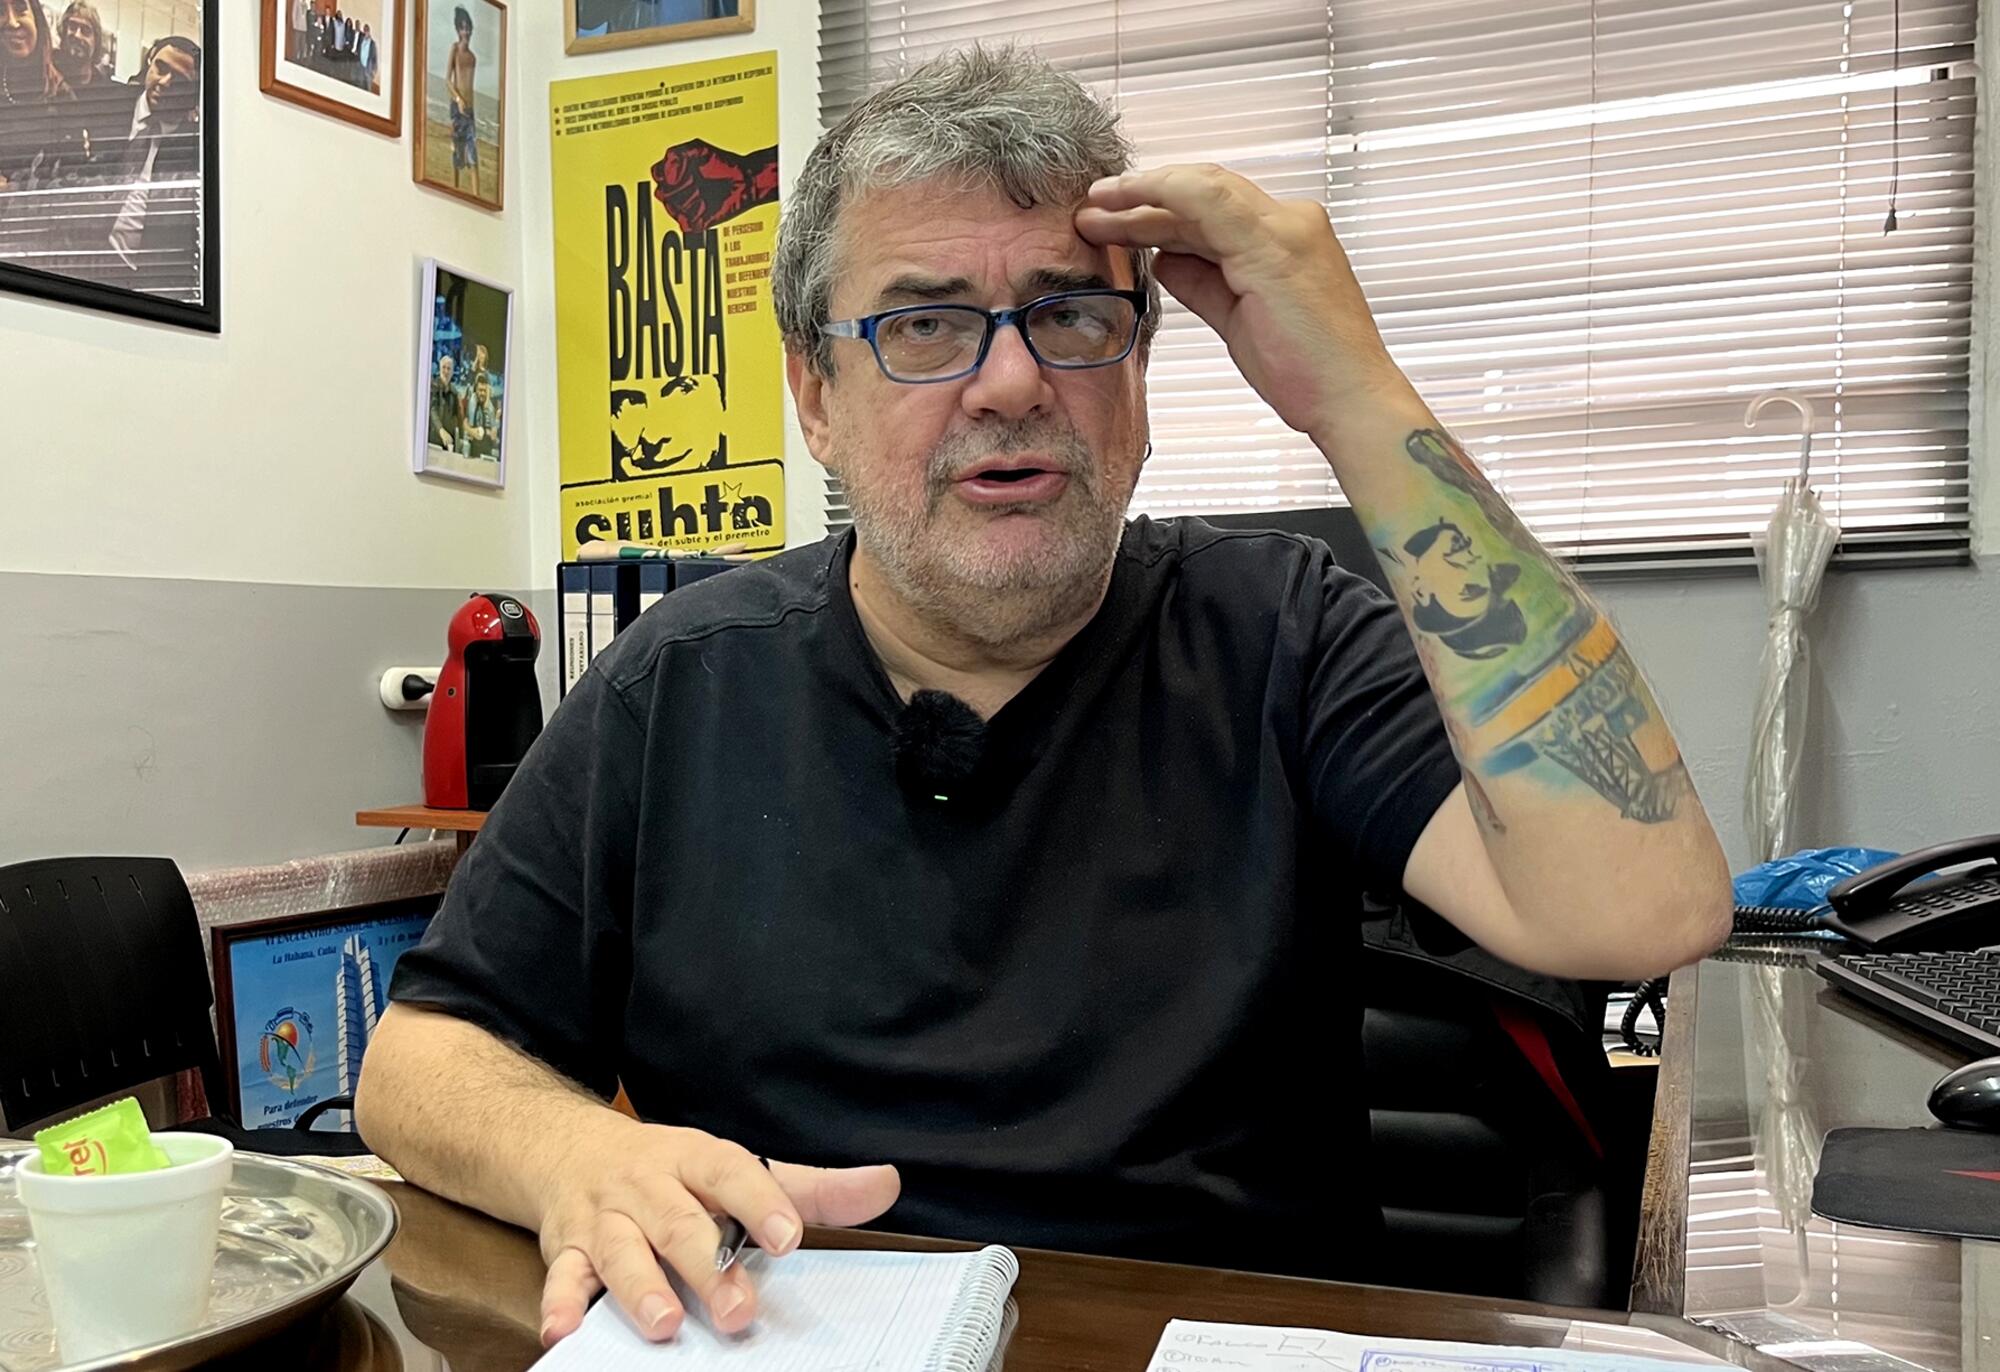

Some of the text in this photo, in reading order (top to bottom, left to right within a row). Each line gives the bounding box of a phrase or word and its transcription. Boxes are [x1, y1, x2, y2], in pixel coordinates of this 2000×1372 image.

[605, 181, 727, 381] BASTA
[575, 492, 653, 508] asociación gremial
[657, 539, 673, 548] del
[675, 536, 702, 546] subte
[714, 533, 723, 542] el
[725, 529, 770, 543] premetro
[273, 954, 282, 965] La
[264, 1103, 283, 1116] Para
